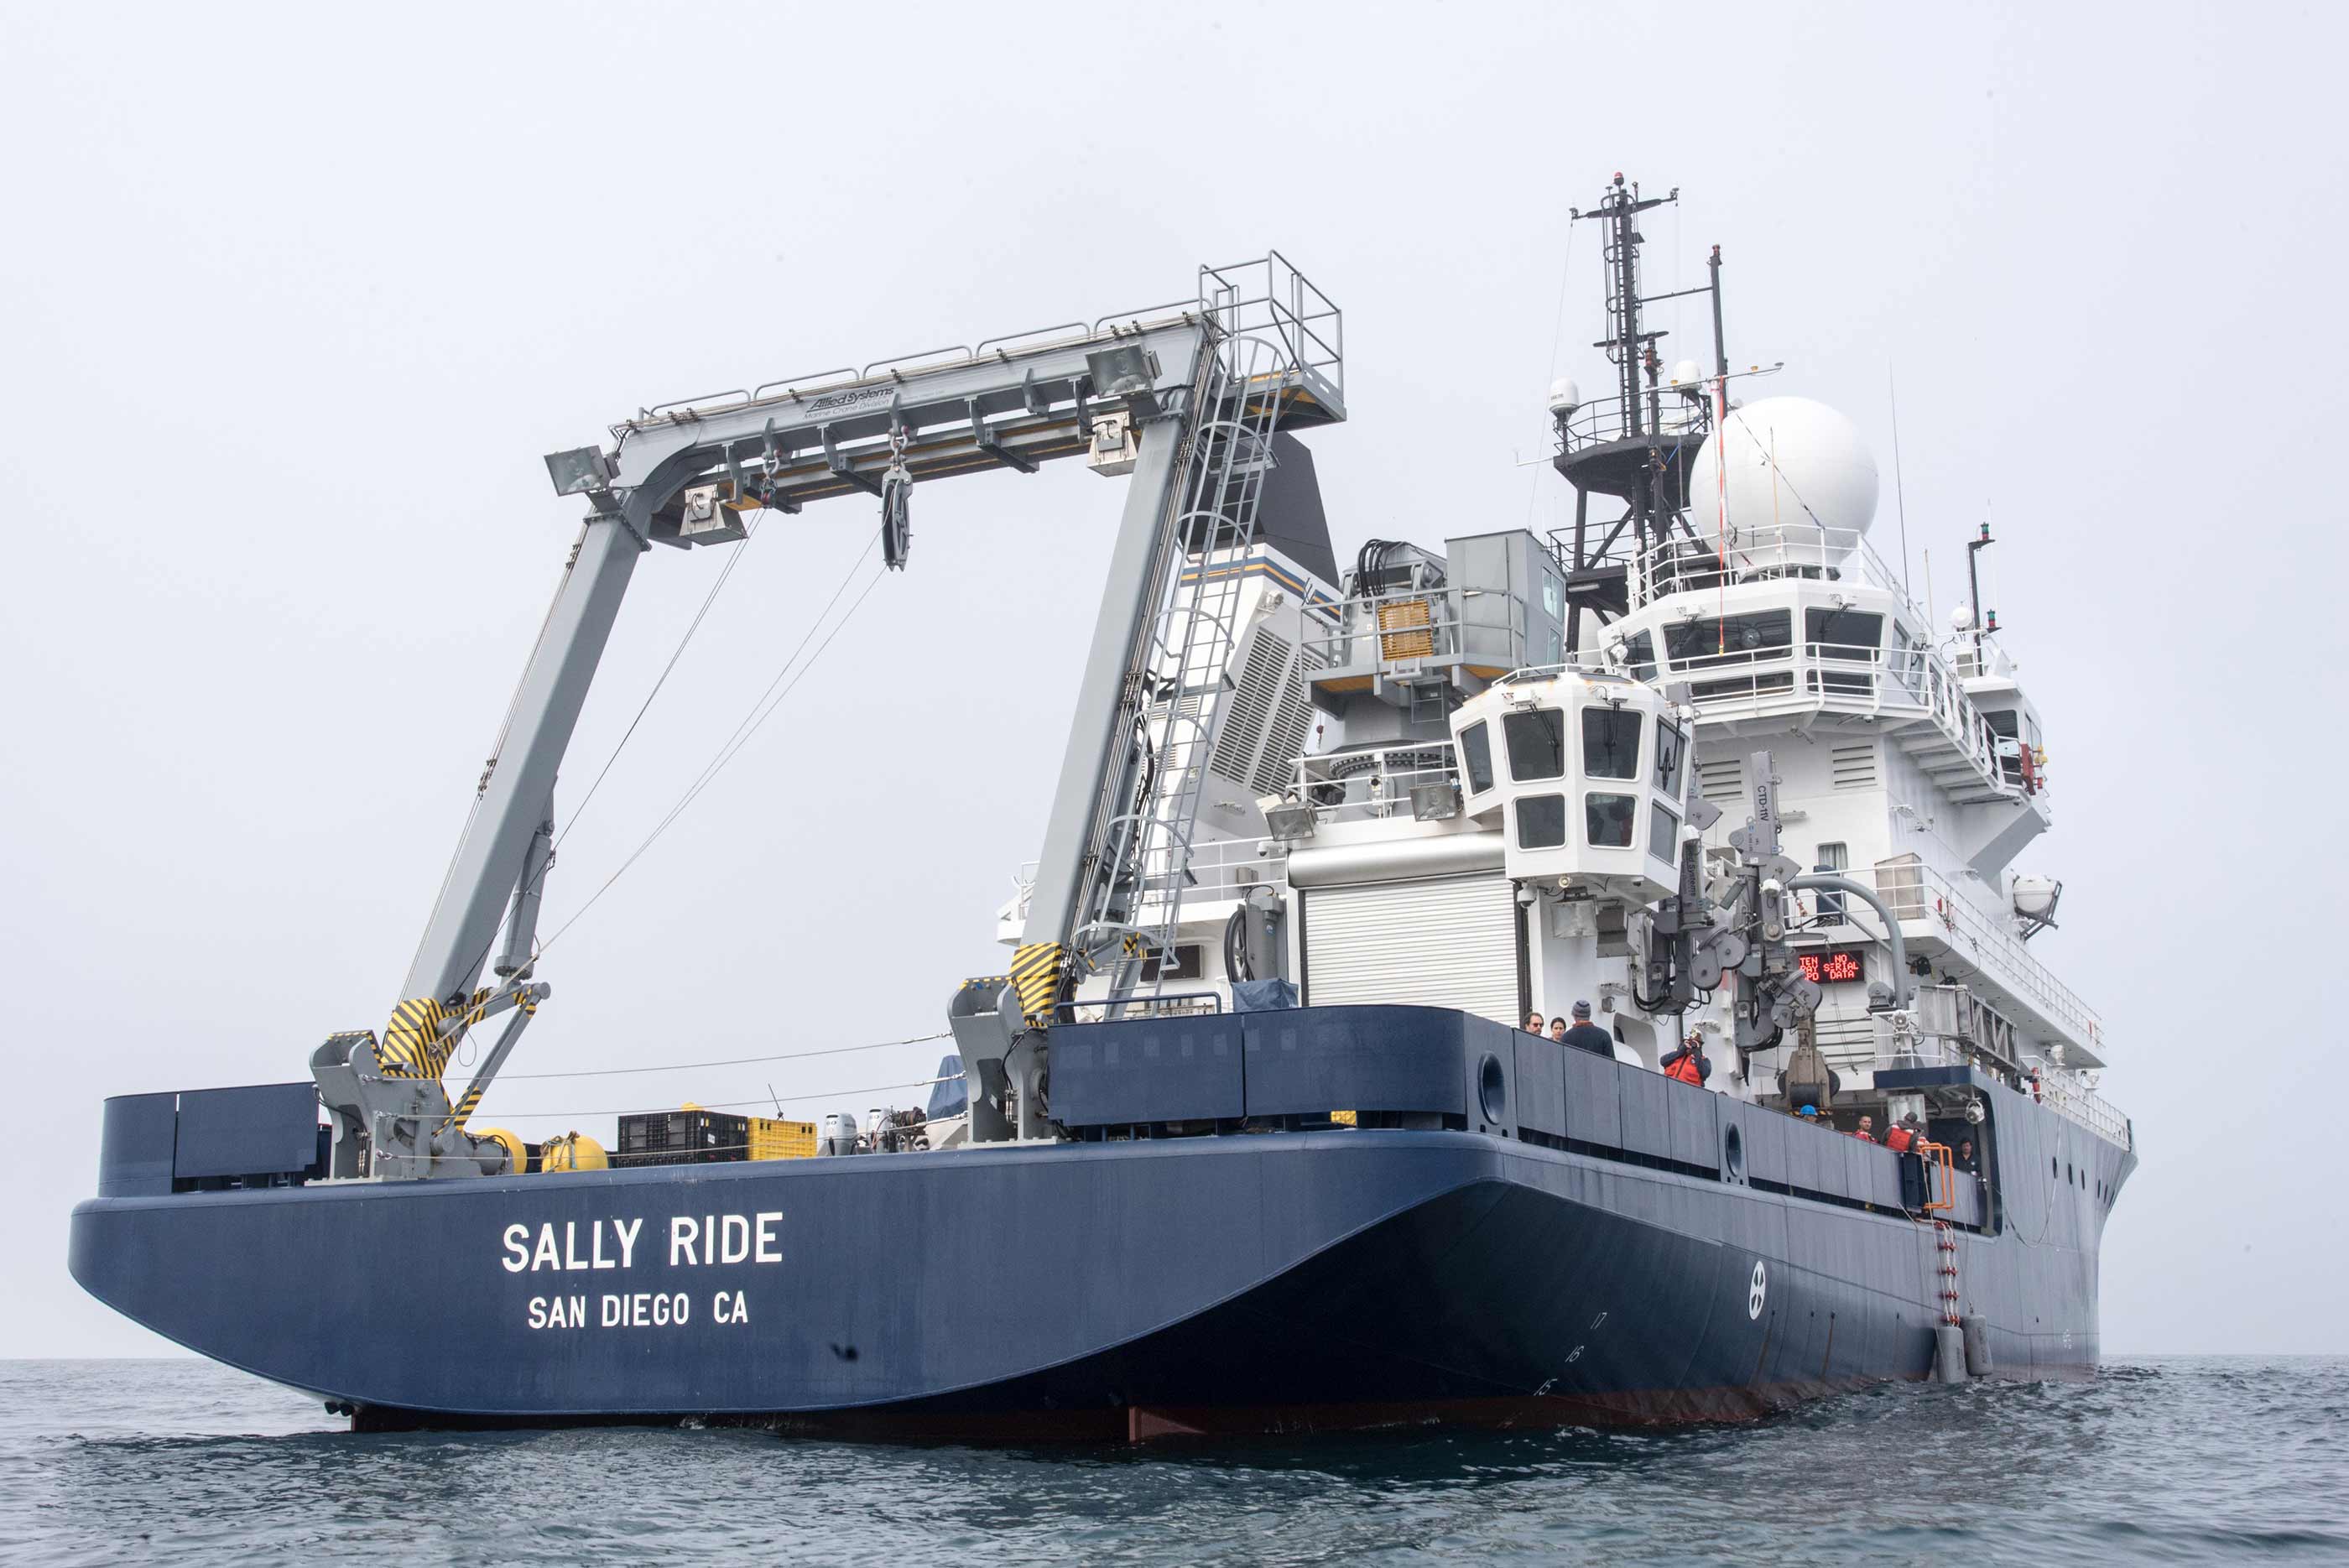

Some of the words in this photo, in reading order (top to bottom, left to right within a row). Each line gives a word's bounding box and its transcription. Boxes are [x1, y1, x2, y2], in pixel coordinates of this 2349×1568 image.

[810, 393, 848, 409] Allied
[848, 388, 894, 403] Systems
[1800, 956, 1818, 966] TEN
[1823, 961, 1858, 972] SERIAL
[1835, 955, 1847, 963] NO
[1805, 972, 1819, 981] PD
[1830, 970, 1854, 979] DATA
[502, 1218, 643, 1273] SALLY
[670, 1212, 784, 1267] RIDE
[529, 1295, 586, 1329] SAN
[602, 1293, 690, 1327] DIEGO
[714, 1290, 748, 1324] CA
[1590, 1311, 1608, 1330] 17
[1565, 1345, 1585, 1363] 16
[1533, 1378, 1558, 1396] 15
